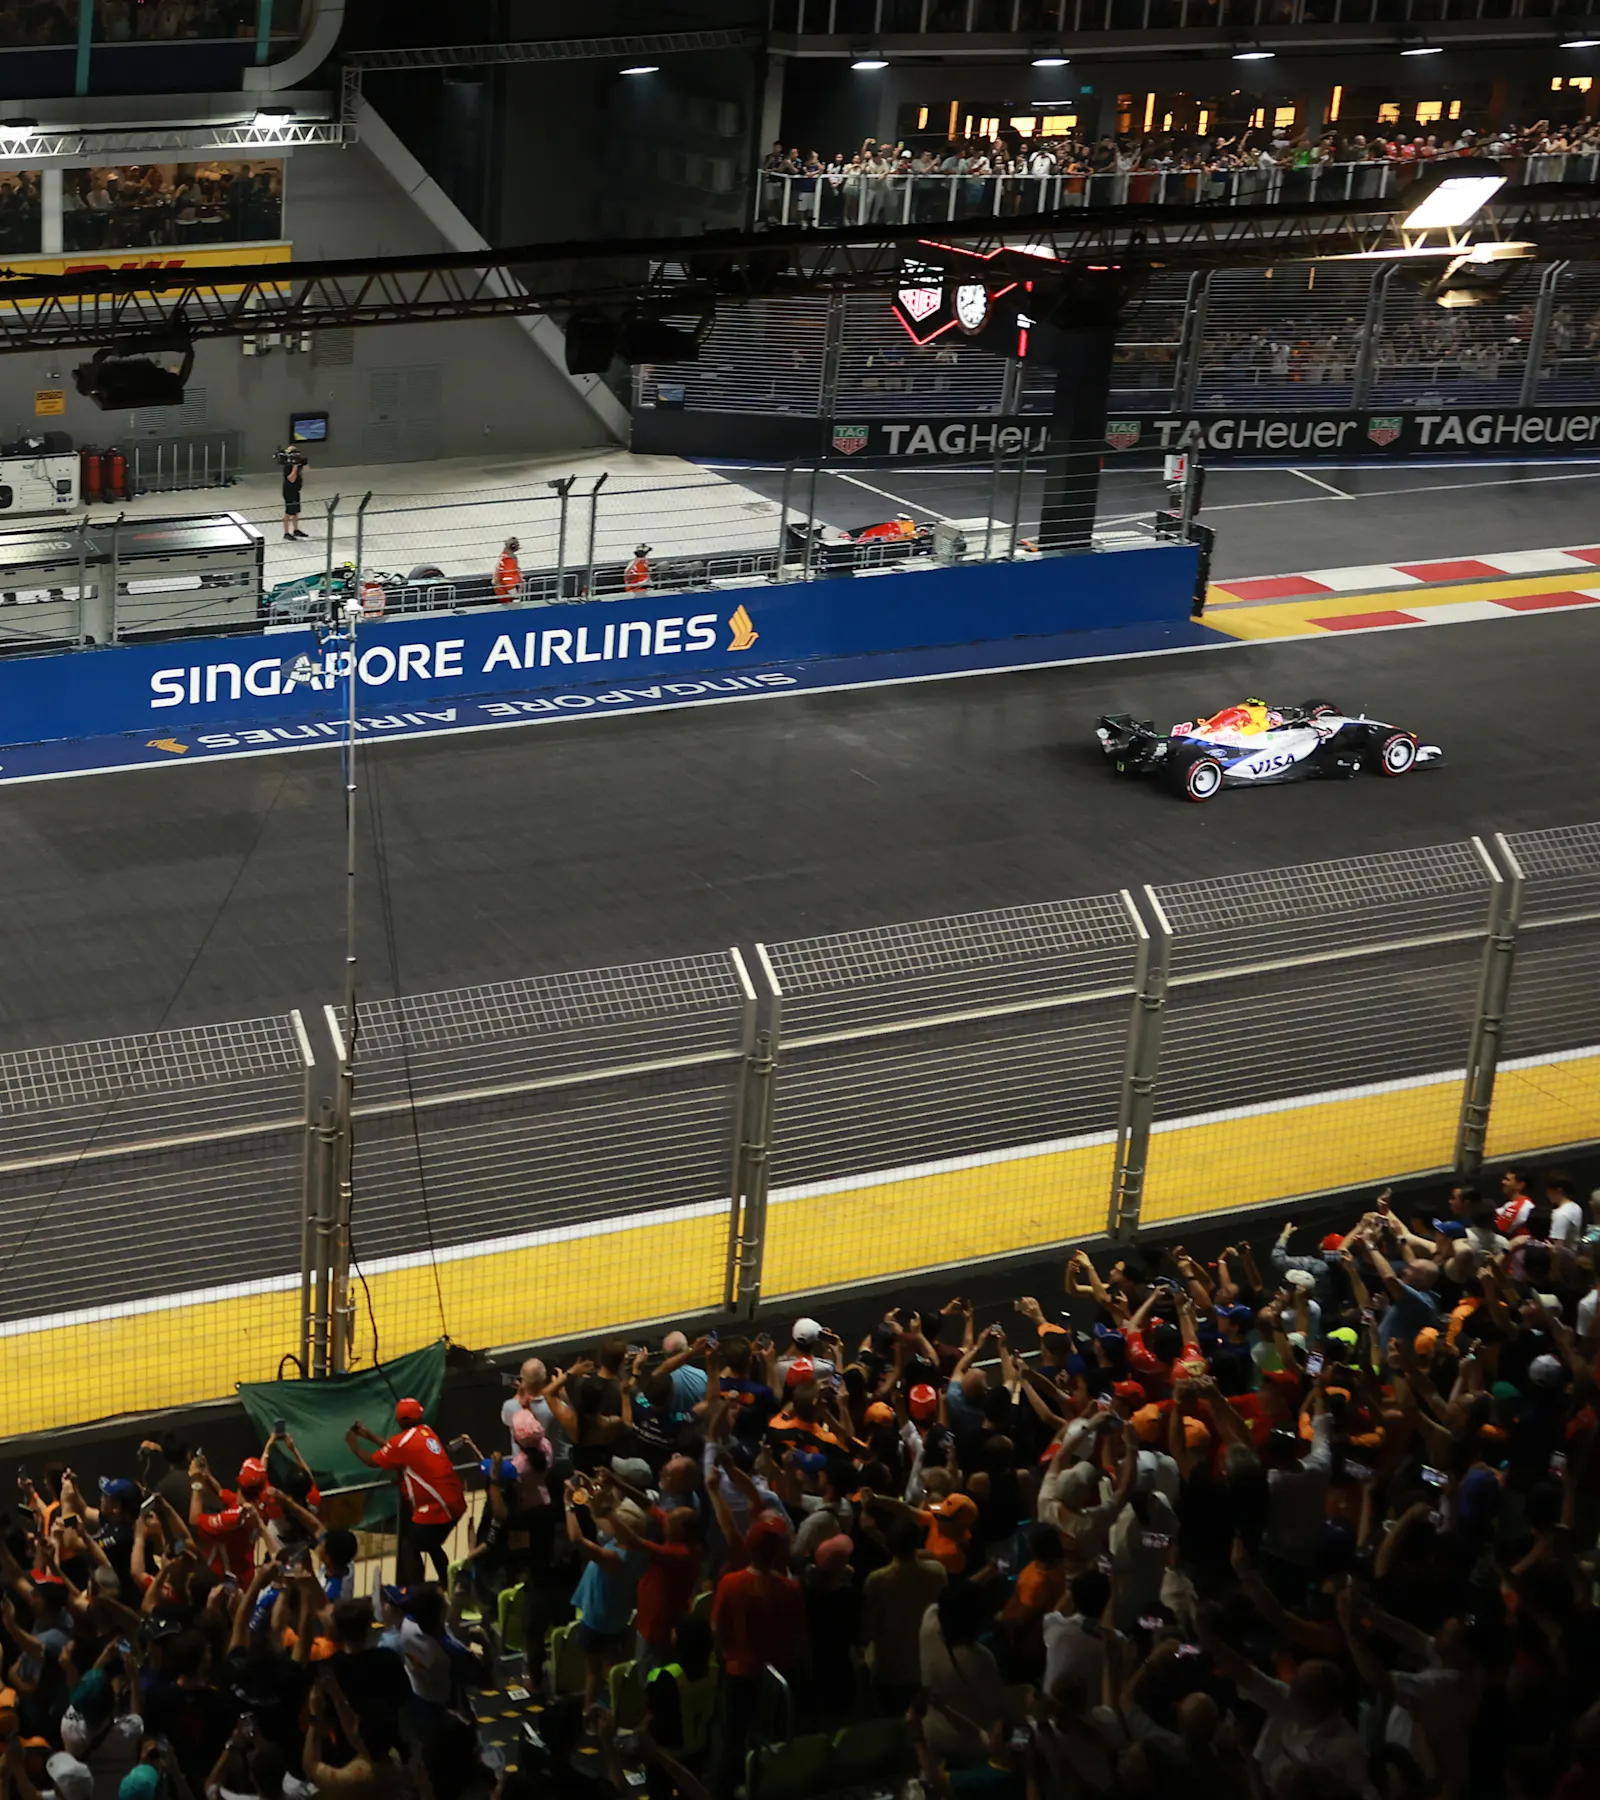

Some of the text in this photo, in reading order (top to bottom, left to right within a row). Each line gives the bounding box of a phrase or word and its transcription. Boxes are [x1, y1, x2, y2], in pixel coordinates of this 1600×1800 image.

[836, 426, 865, 437] TAG
[881, 423, 1049, 454] TAGHeu
[1109, 422, 1138, 433] TAG
[1153, 419, 1358, 450] TAGHeuer
[149, 613, 718, 709] SINGAPORE AIRLINES
[197, 672, 799, 750] SINGAPORE AIRLINES
[1250, 752, 1295, 775] VISA
